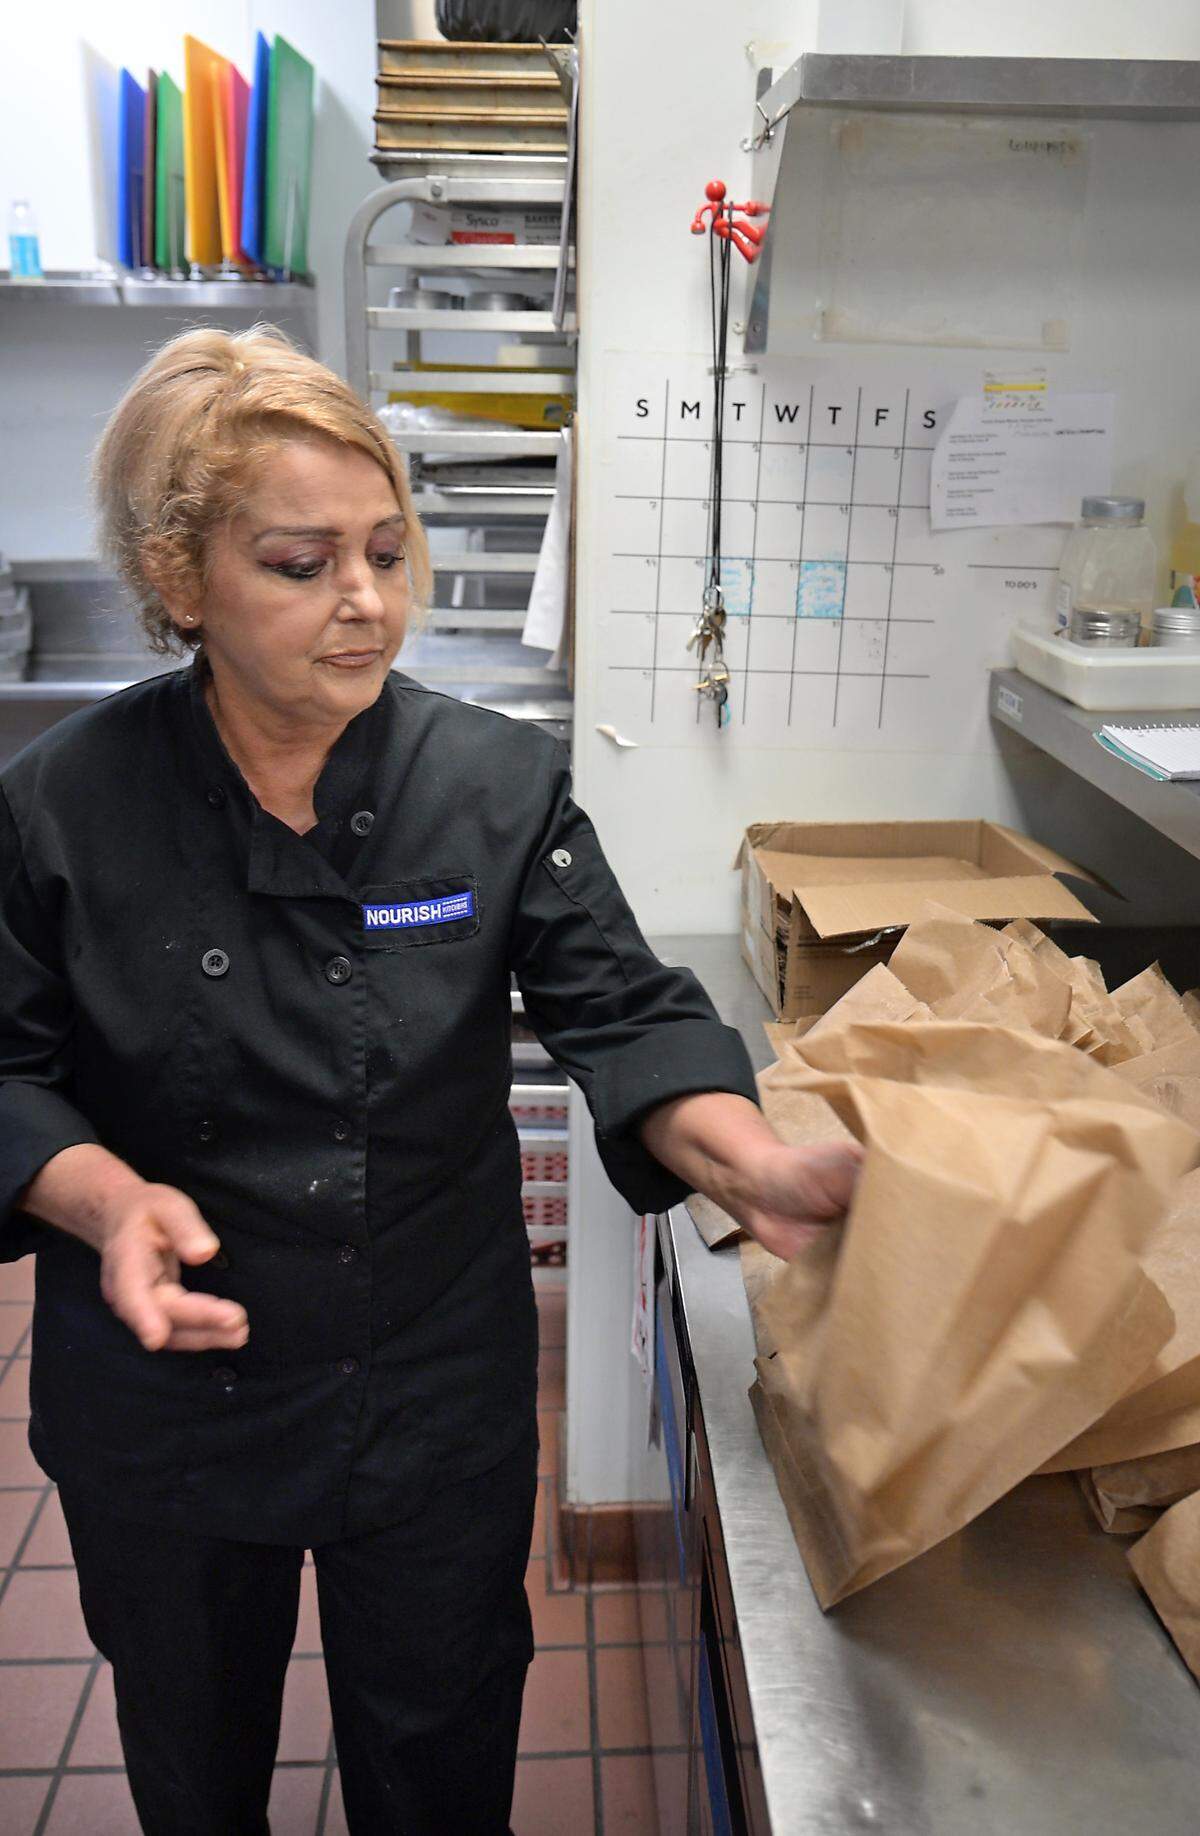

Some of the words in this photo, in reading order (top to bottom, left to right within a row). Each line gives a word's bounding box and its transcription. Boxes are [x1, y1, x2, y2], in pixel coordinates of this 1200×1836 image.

[466, 213, 499, 228] Sysco
[636, 399, 649, 418] S
[681, 400, 701, 419] M
[732, 402, 746, 421] T
[774, 404, 800, 423] W
[828, 406, 842, 425] T
[874, 408, 889, 426] F
[922, 410, 936, 429] S
[366, 903, 441, 925] NOURISH
